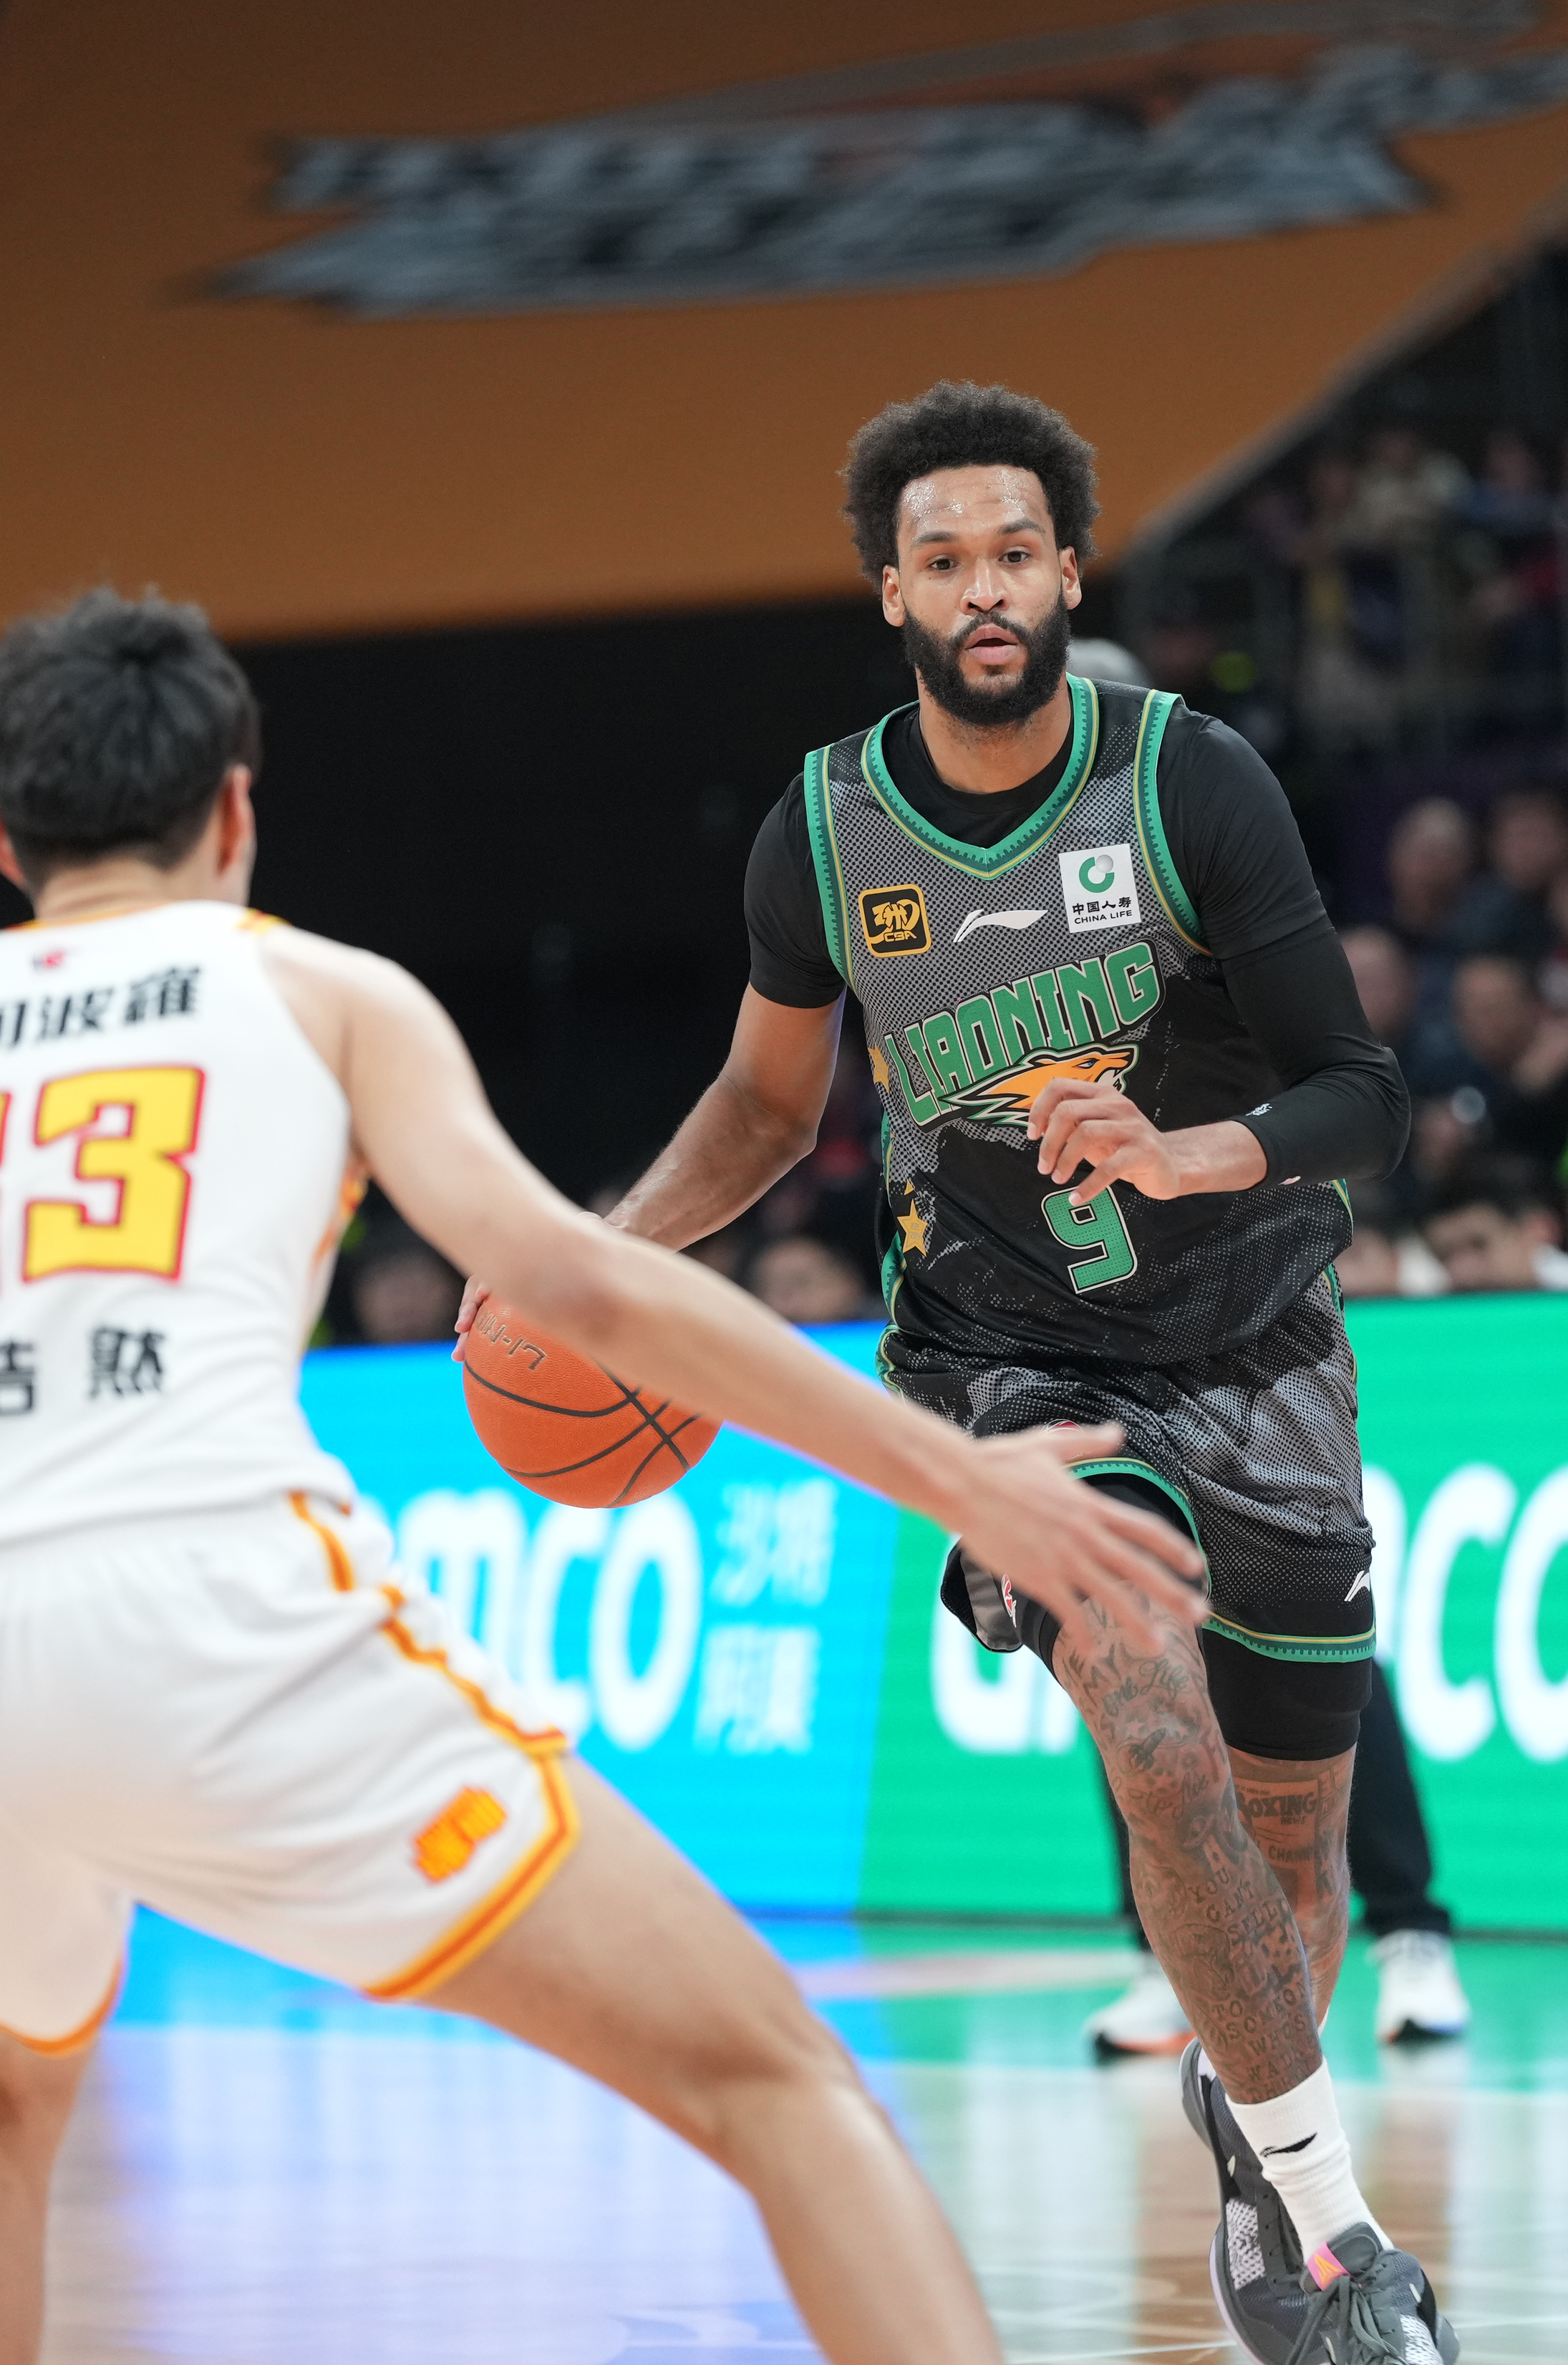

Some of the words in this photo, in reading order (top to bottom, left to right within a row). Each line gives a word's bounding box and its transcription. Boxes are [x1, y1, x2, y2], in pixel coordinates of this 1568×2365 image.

[1072, 896, 1132, 916] 中国人寿
[1074, 914, 1108, 924] CHINA
[1110, 909, 1133, 919] LIFE
[883, 930, 917, 942] CBA
[885, 942, 1161, 1126] LIAONING
[0, 1065, 206, 1283] 3
[1042, 1184, 1138, 1295] 9
[1187, 1866, 1230, 1904] YOU
